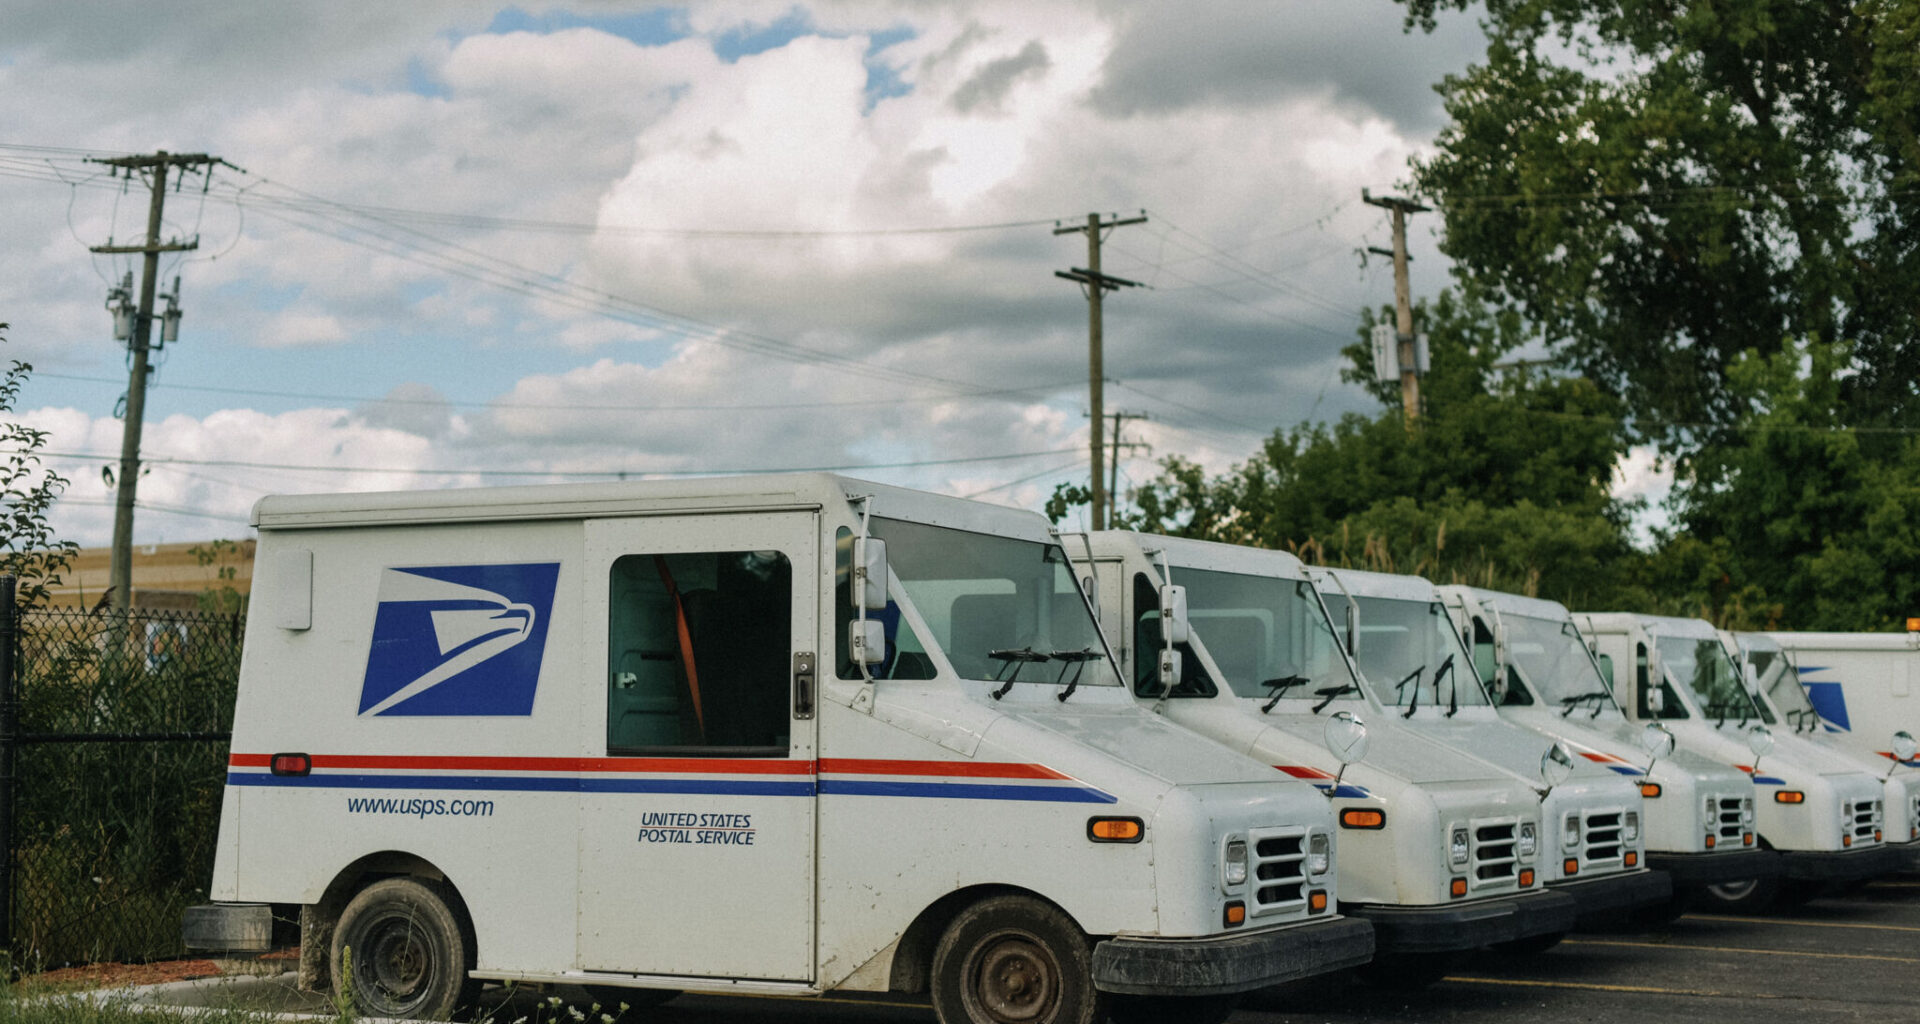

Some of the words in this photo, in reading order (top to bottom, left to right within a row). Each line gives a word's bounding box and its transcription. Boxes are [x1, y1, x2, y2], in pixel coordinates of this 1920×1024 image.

[348, 798, 494, 819] www.usps.com
[641, 812, 697, 826] UNITED
[699, 813, 751, 828] STATES
[638, 829, 692, 843] POSTAL
[695, 830, 755, 845] SERVICE
